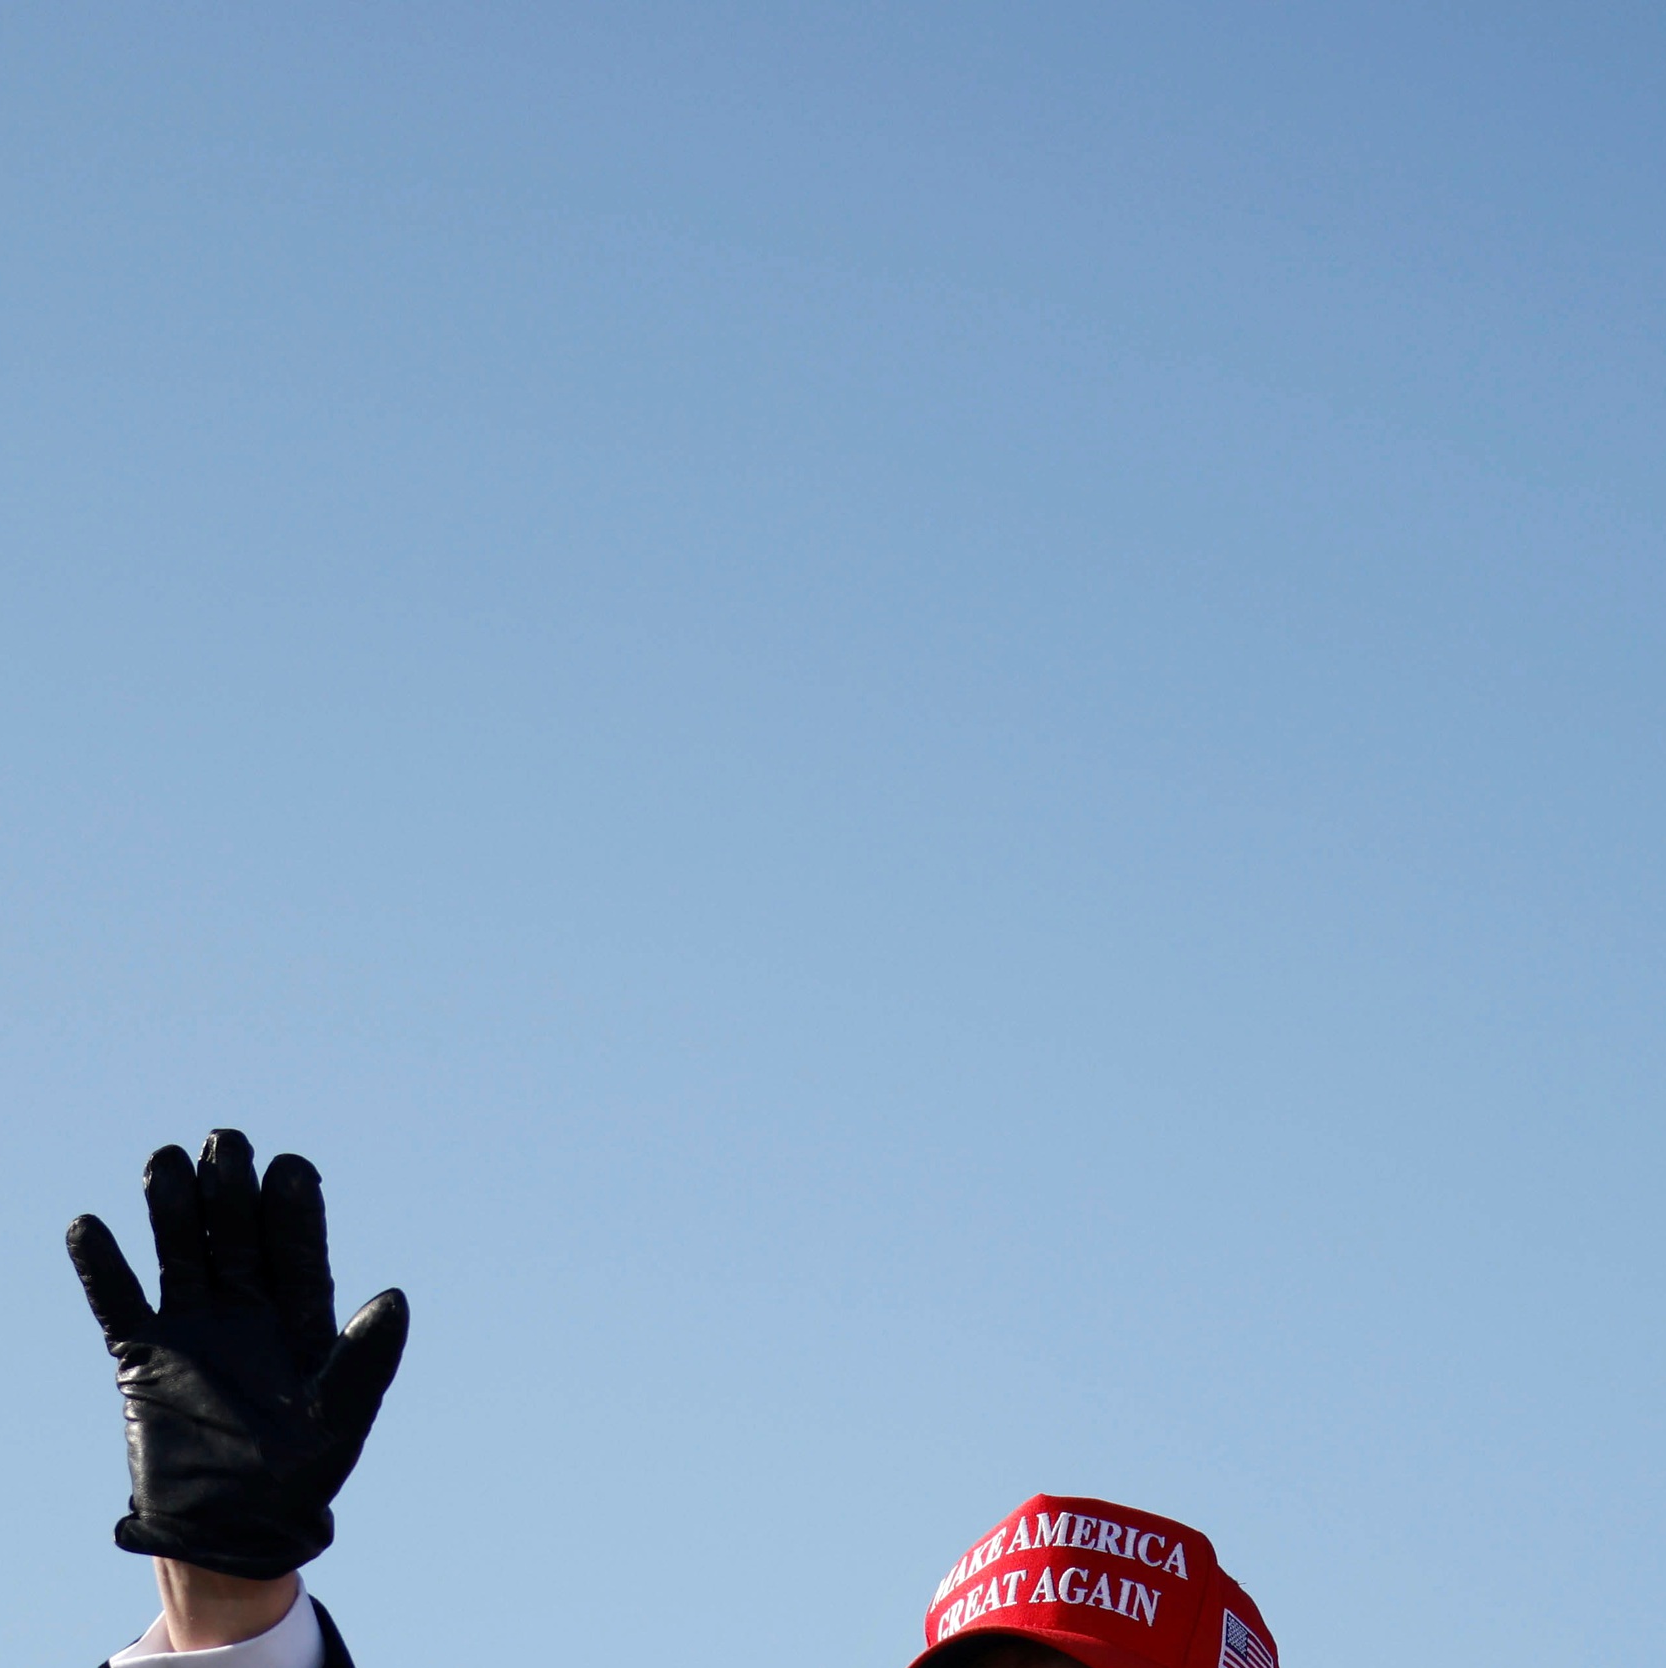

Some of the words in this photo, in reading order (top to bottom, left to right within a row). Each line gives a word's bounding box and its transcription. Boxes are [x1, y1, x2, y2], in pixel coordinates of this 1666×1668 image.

[930, 1526, 1008, 1613] MAKE
[1007, 1510, 1190, 1581] AMERICA
[936, 1568, 1028, 1643] GREAT
[1027, 1565, 1162, 1628] AGAIN
